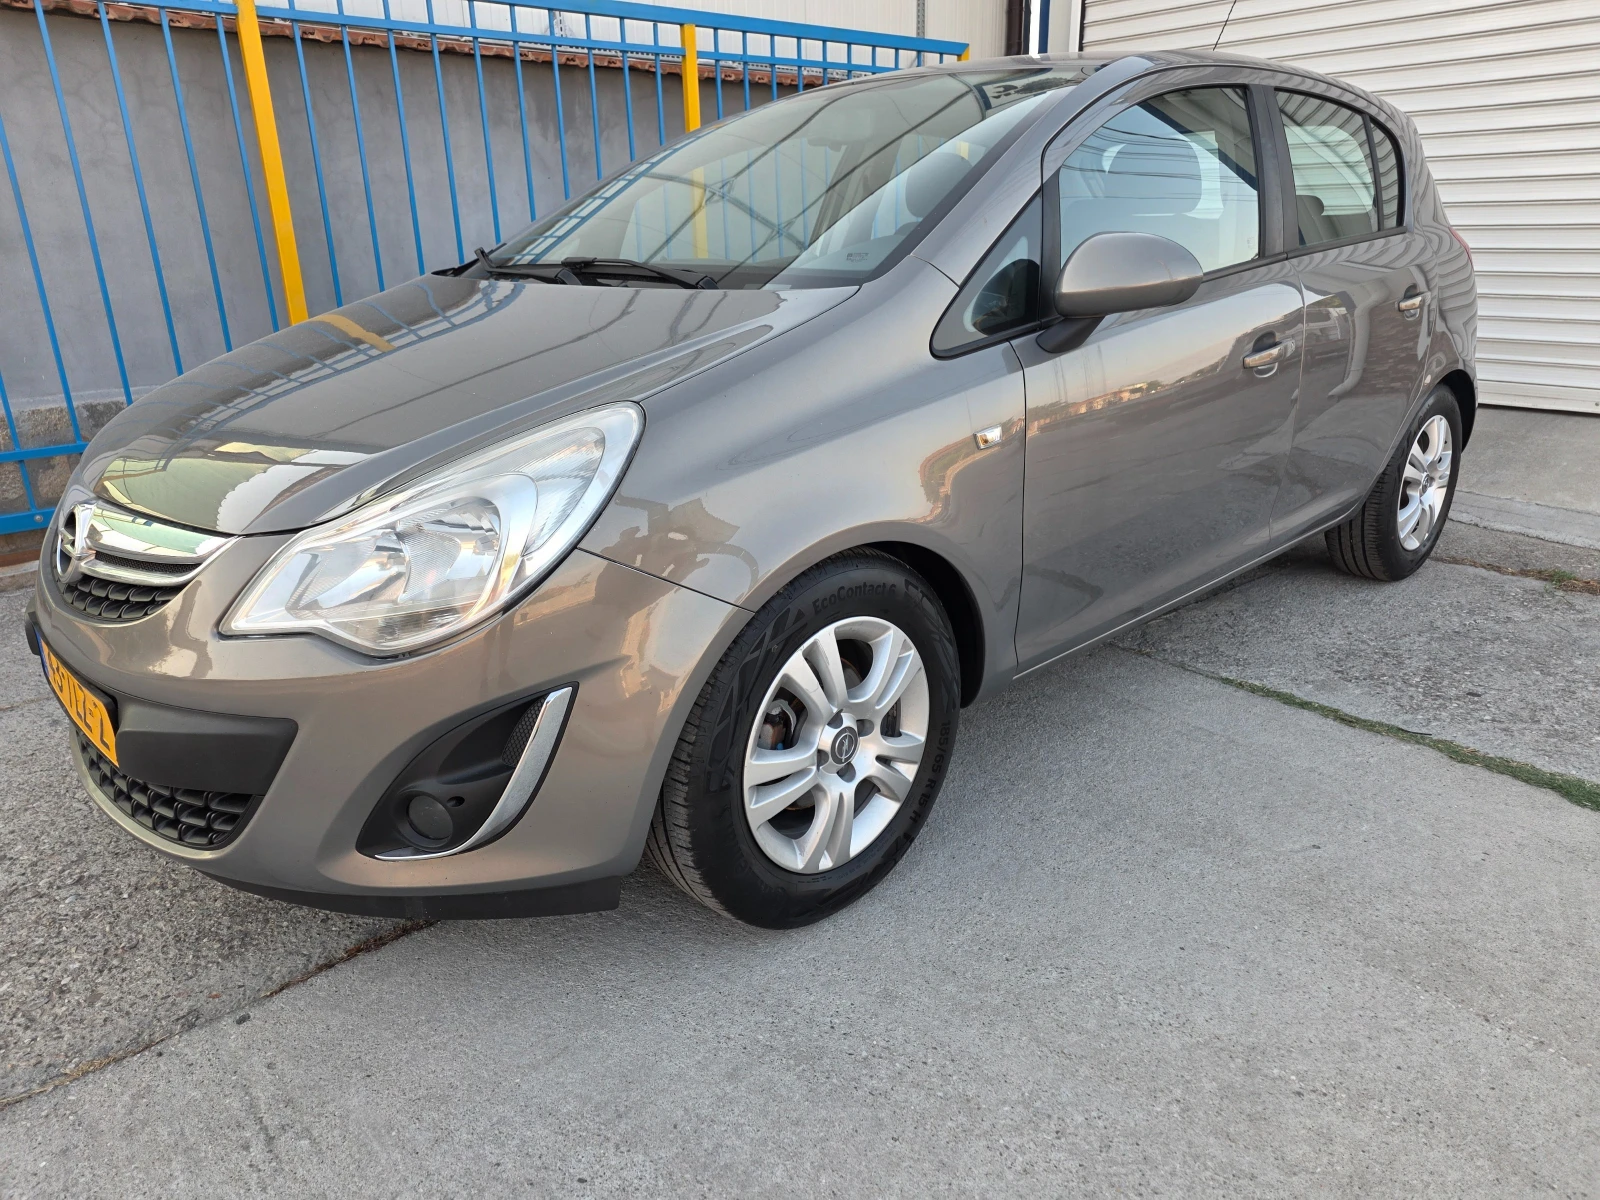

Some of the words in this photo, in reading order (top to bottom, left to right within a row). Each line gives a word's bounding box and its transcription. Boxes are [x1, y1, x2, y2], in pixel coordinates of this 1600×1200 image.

[811, 581, 887, 615] EcoContact
[931, 720, 951, 773] 185/65
[924, 778, 937, 790] R
[918, 792, 932, 808] 15
